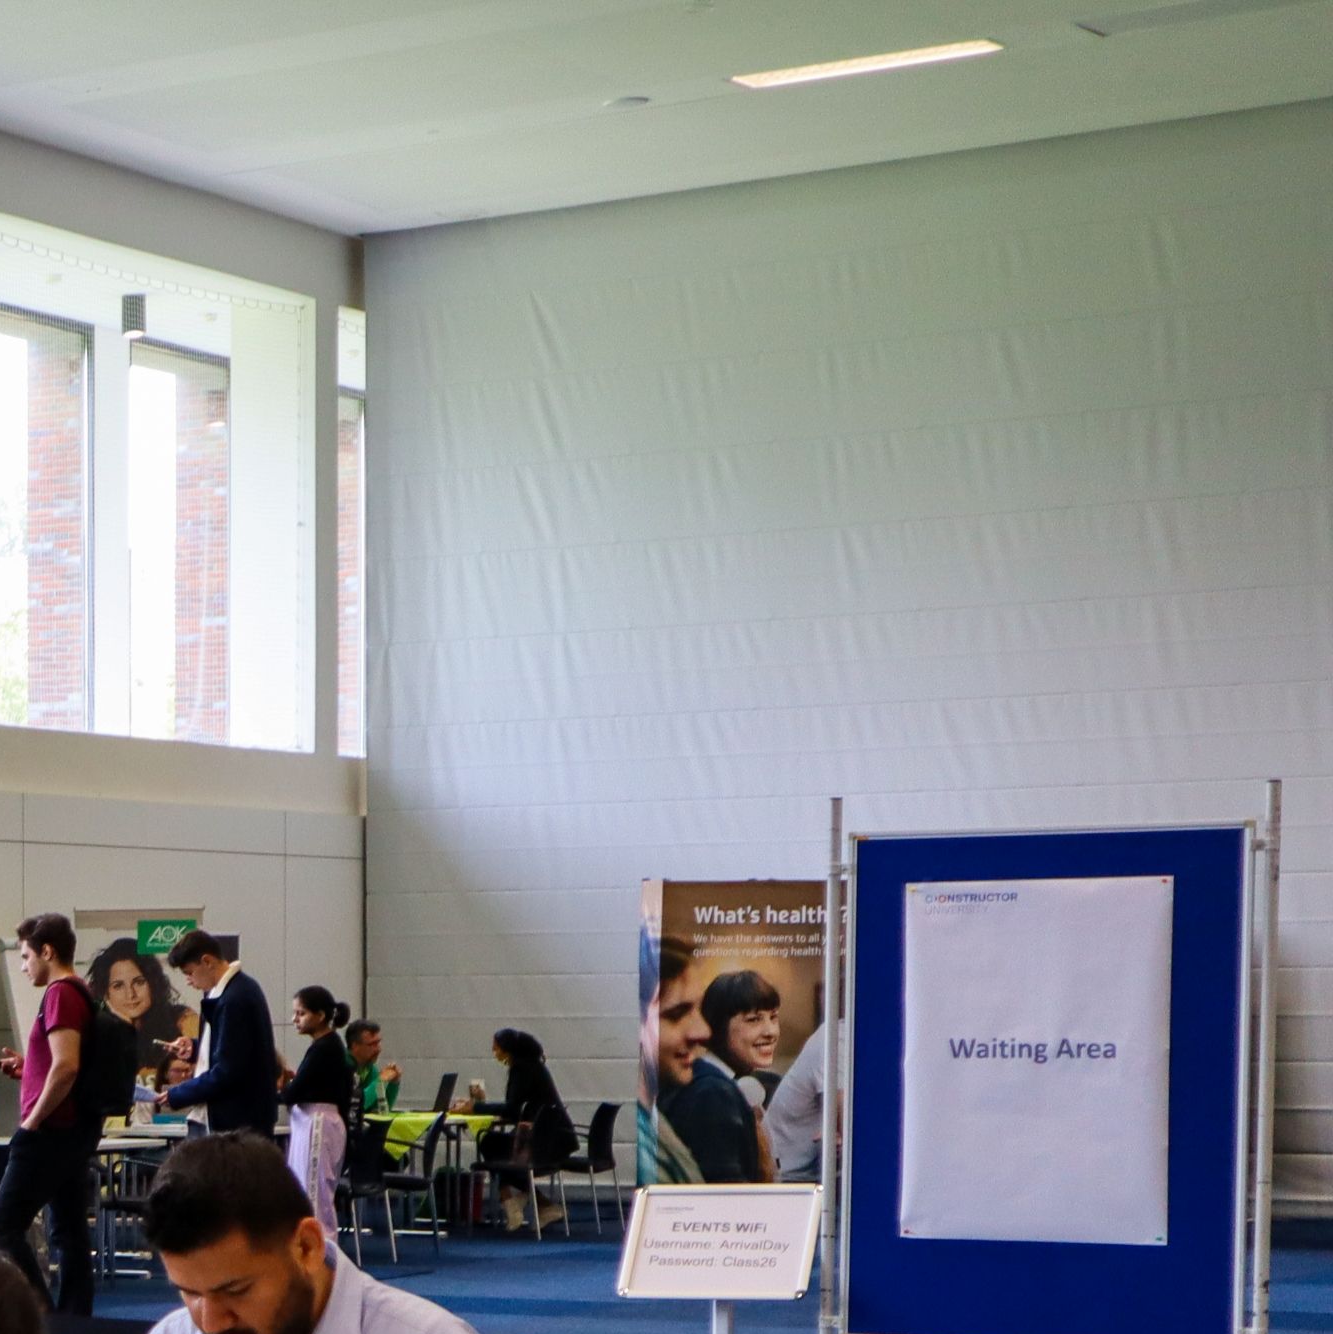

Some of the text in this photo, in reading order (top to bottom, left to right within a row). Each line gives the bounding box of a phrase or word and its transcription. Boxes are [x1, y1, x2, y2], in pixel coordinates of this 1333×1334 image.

[694, 905, 760, 924] What's
[147, 925, 187, 944] AOK
[693, 933, 843, 946] We have the answers to all yr
[693, 948, 737, 958] questions
[741, 947, 789, 958] regarding
[790, 947, 821, 956] health
[949, 1037, 1117, 1064] Waiting Area
[672, 1221, 767, 1233] EVENTS WiFi
[644, 1238, 790, 1253] Username: ArrivalDay
[649, 1255, 777, 1268] Password: Class26
